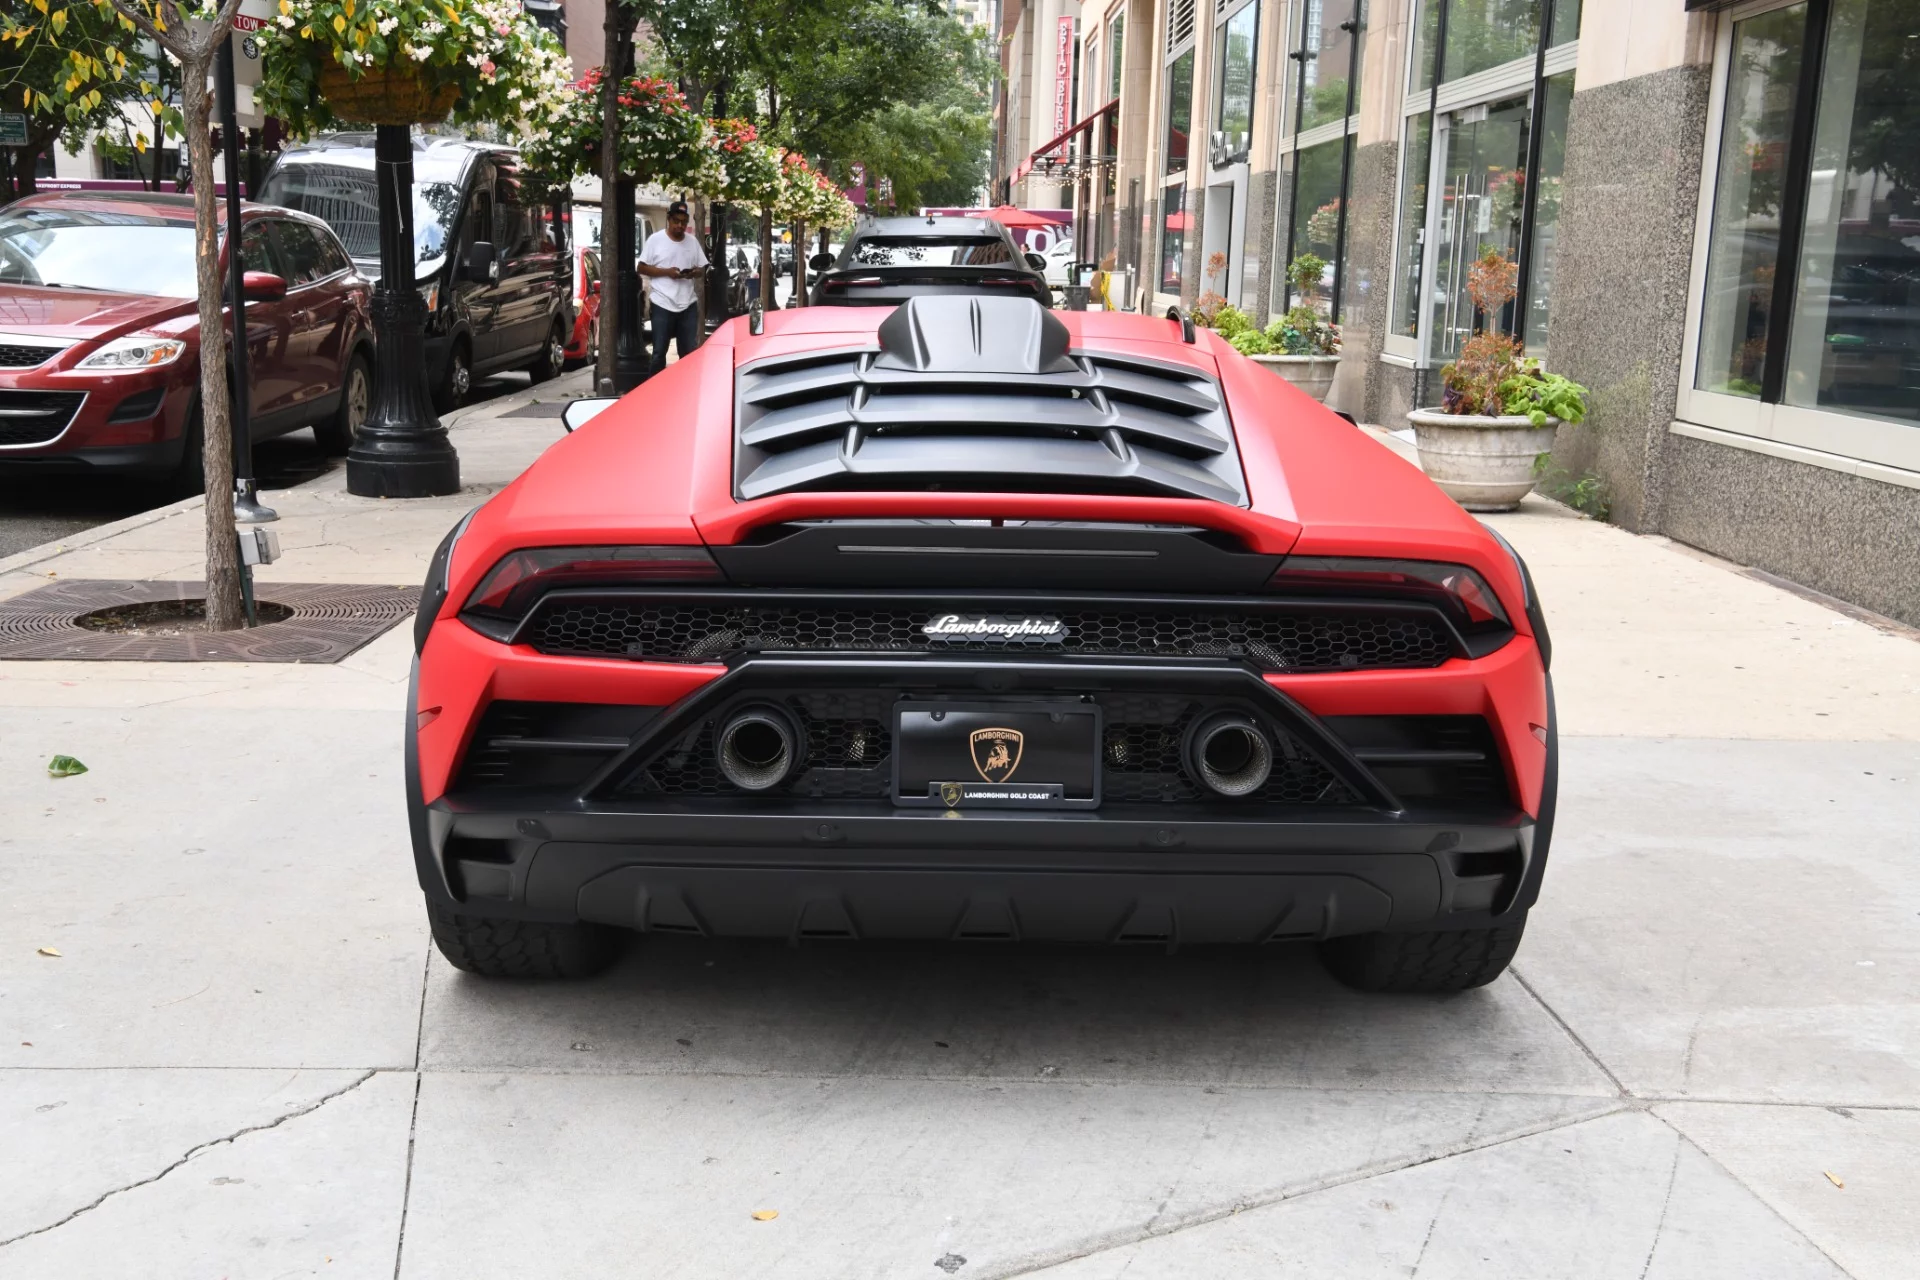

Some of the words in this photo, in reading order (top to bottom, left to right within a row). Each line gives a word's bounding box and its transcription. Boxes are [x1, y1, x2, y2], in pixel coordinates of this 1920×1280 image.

[236, 16, 259, 30] TOW
[1058, 23, 1067, 75] EPIC
[923, 615, 1061, 638] Lamborghini
[974, 731, 1020, 743] LAMBORGHINI
